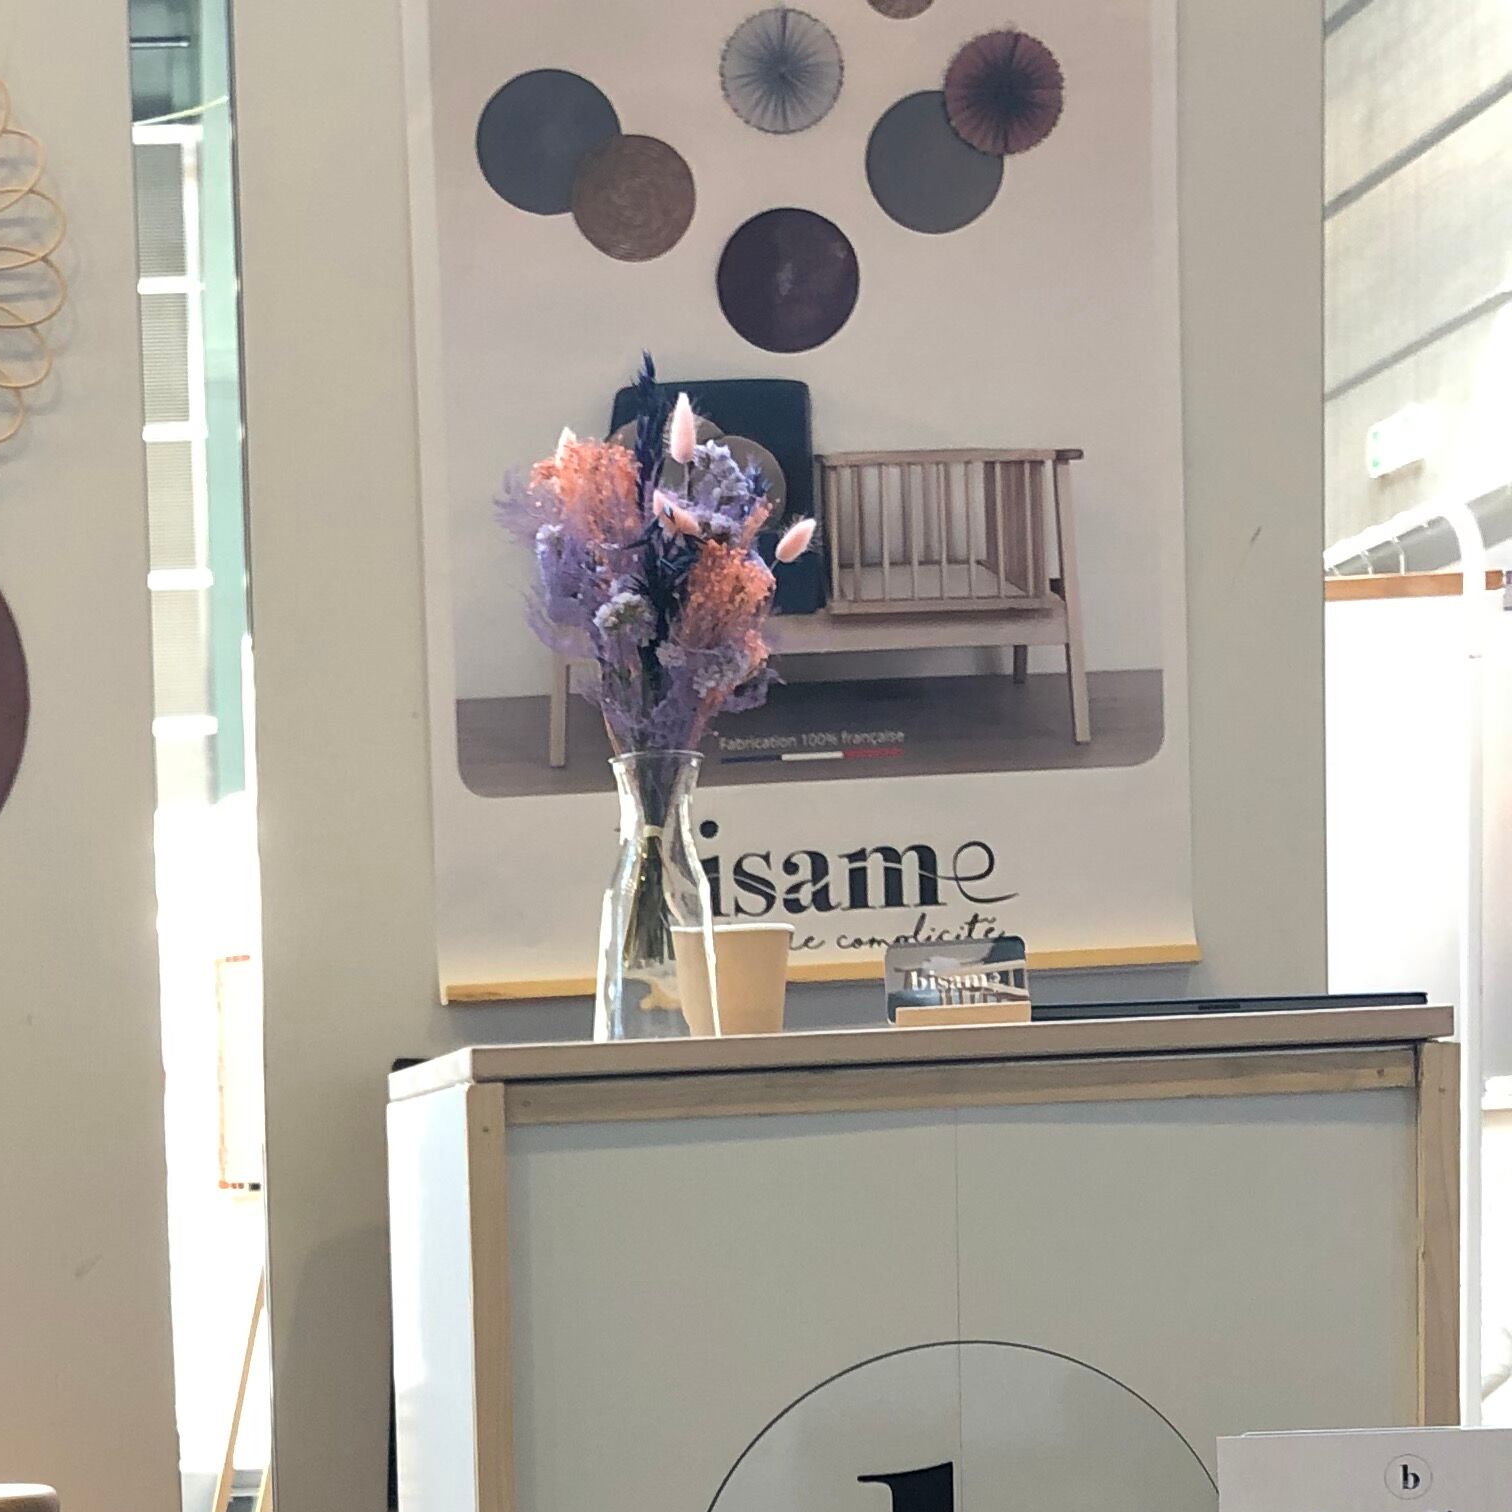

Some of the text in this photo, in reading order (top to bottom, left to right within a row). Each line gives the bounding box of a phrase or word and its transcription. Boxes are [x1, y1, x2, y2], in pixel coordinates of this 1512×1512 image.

[719, 730, 904, 750] Fabrication 100% française
[697, 819, 1020, 918] isame
[1400, 1464, 1420, 1490] b
